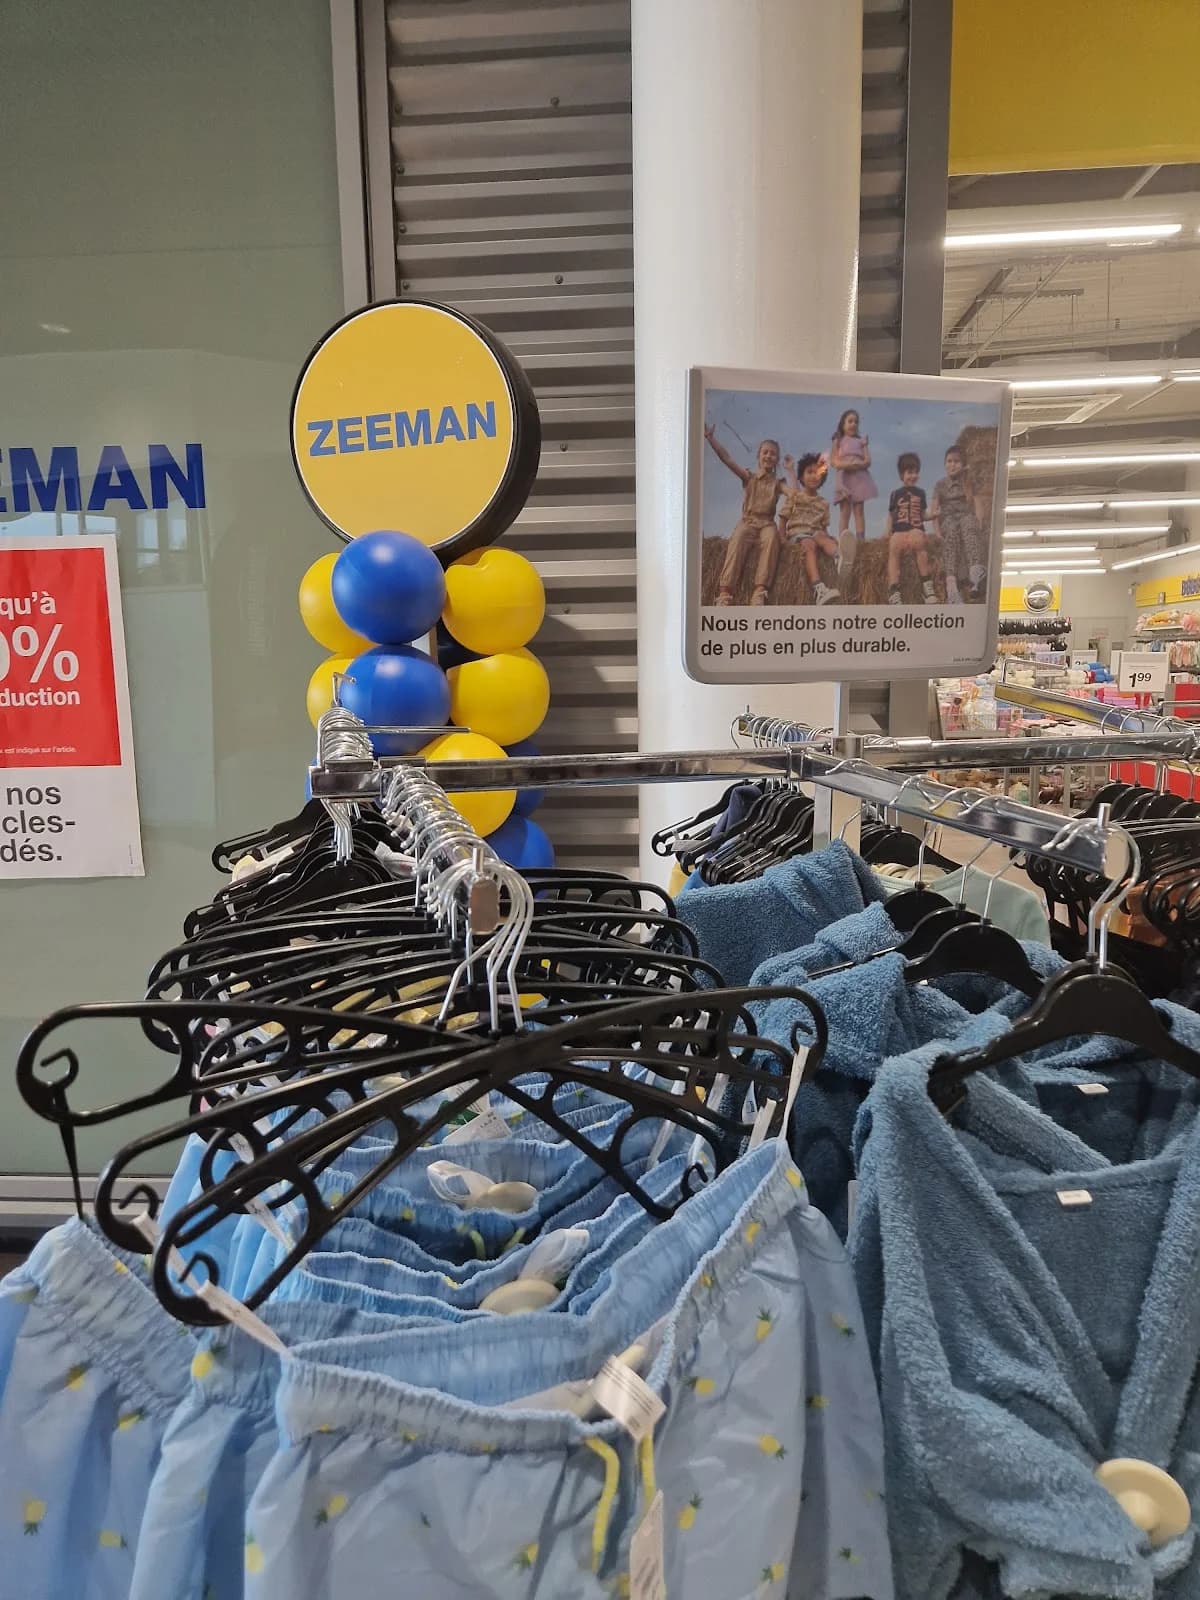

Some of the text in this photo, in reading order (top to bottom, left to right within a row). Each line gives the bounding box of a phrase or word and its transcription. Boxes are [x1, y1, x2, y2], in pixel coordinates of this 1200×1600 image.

[307, 401, 497, 457] ZEEMAN
[0, 443, 206, 513] MAN
[701, 612, 965, 632] Nous rendons notre collection
[701, 636, 911, 659] de plus en plus durable.
[7, 786, 62, 805] nos
[2, 810, 75, 834] cles-
[0, 838, 63, 862] dés.
